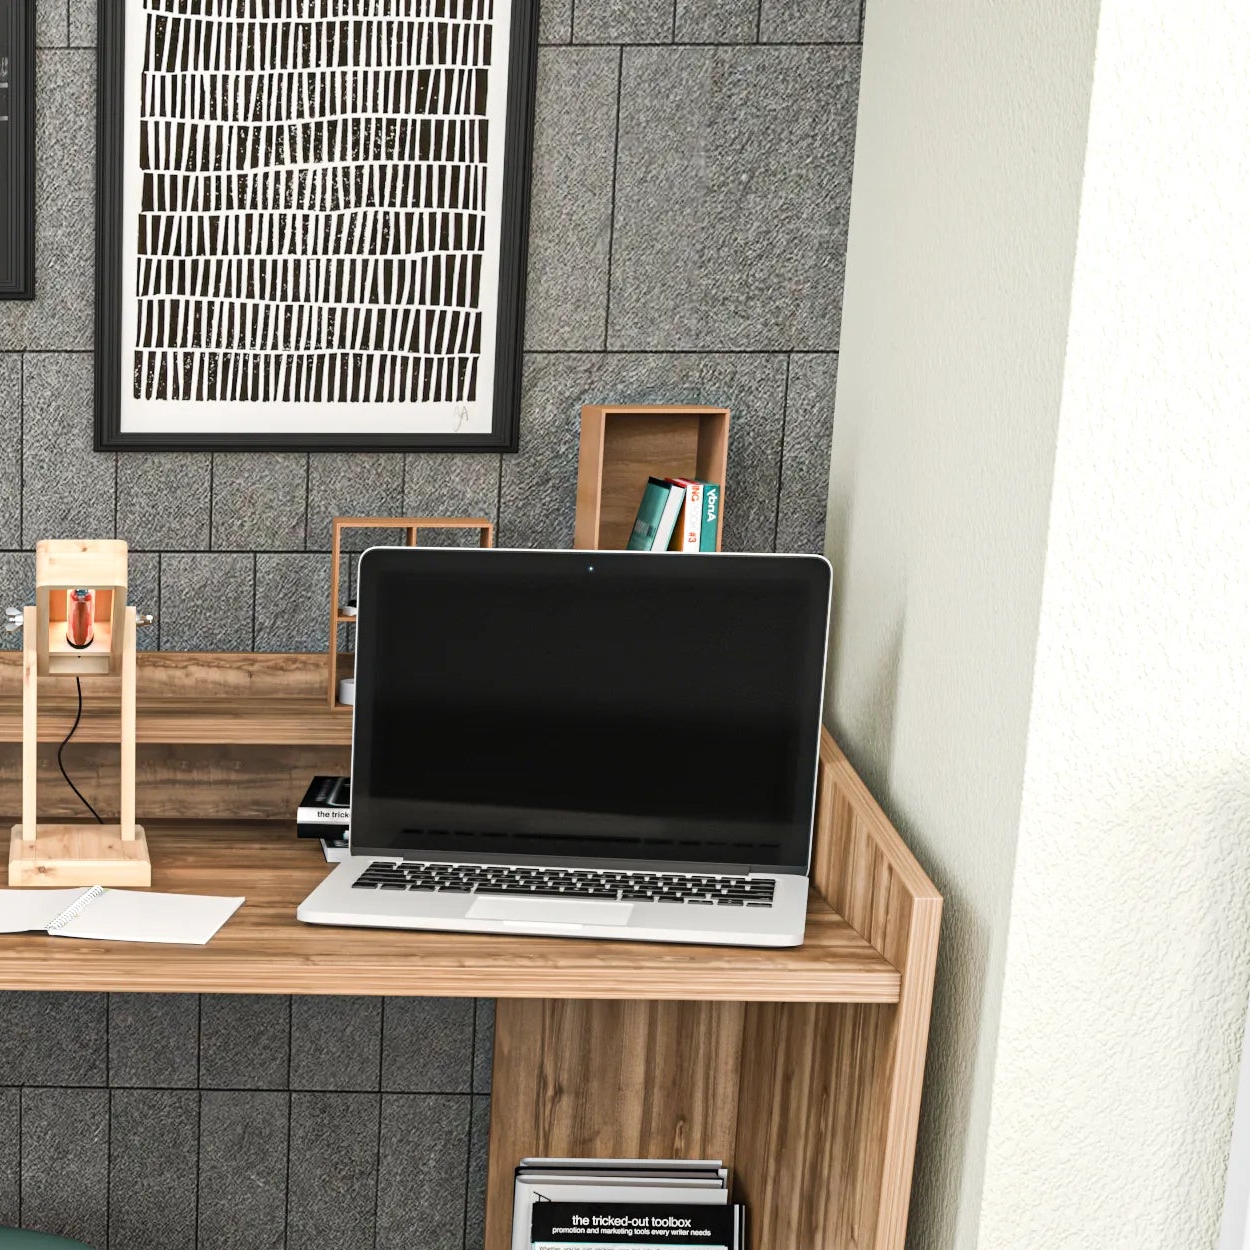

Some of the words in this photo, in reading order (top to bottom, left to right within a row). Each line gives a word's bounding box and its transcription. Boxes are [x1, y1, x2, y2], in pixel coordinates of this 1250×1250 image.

[332, 811, 350, 819] trick
[572, 1215, 589, 1226] the
[592, 1216, 649, 1227] tricked-out
[651, 1217, 691, 1228] toolbox
[552, 1227, 585, 1236] promotion
[600, 1228, 633, 1237] marketing
[651, 1230, 669, 1238] every
